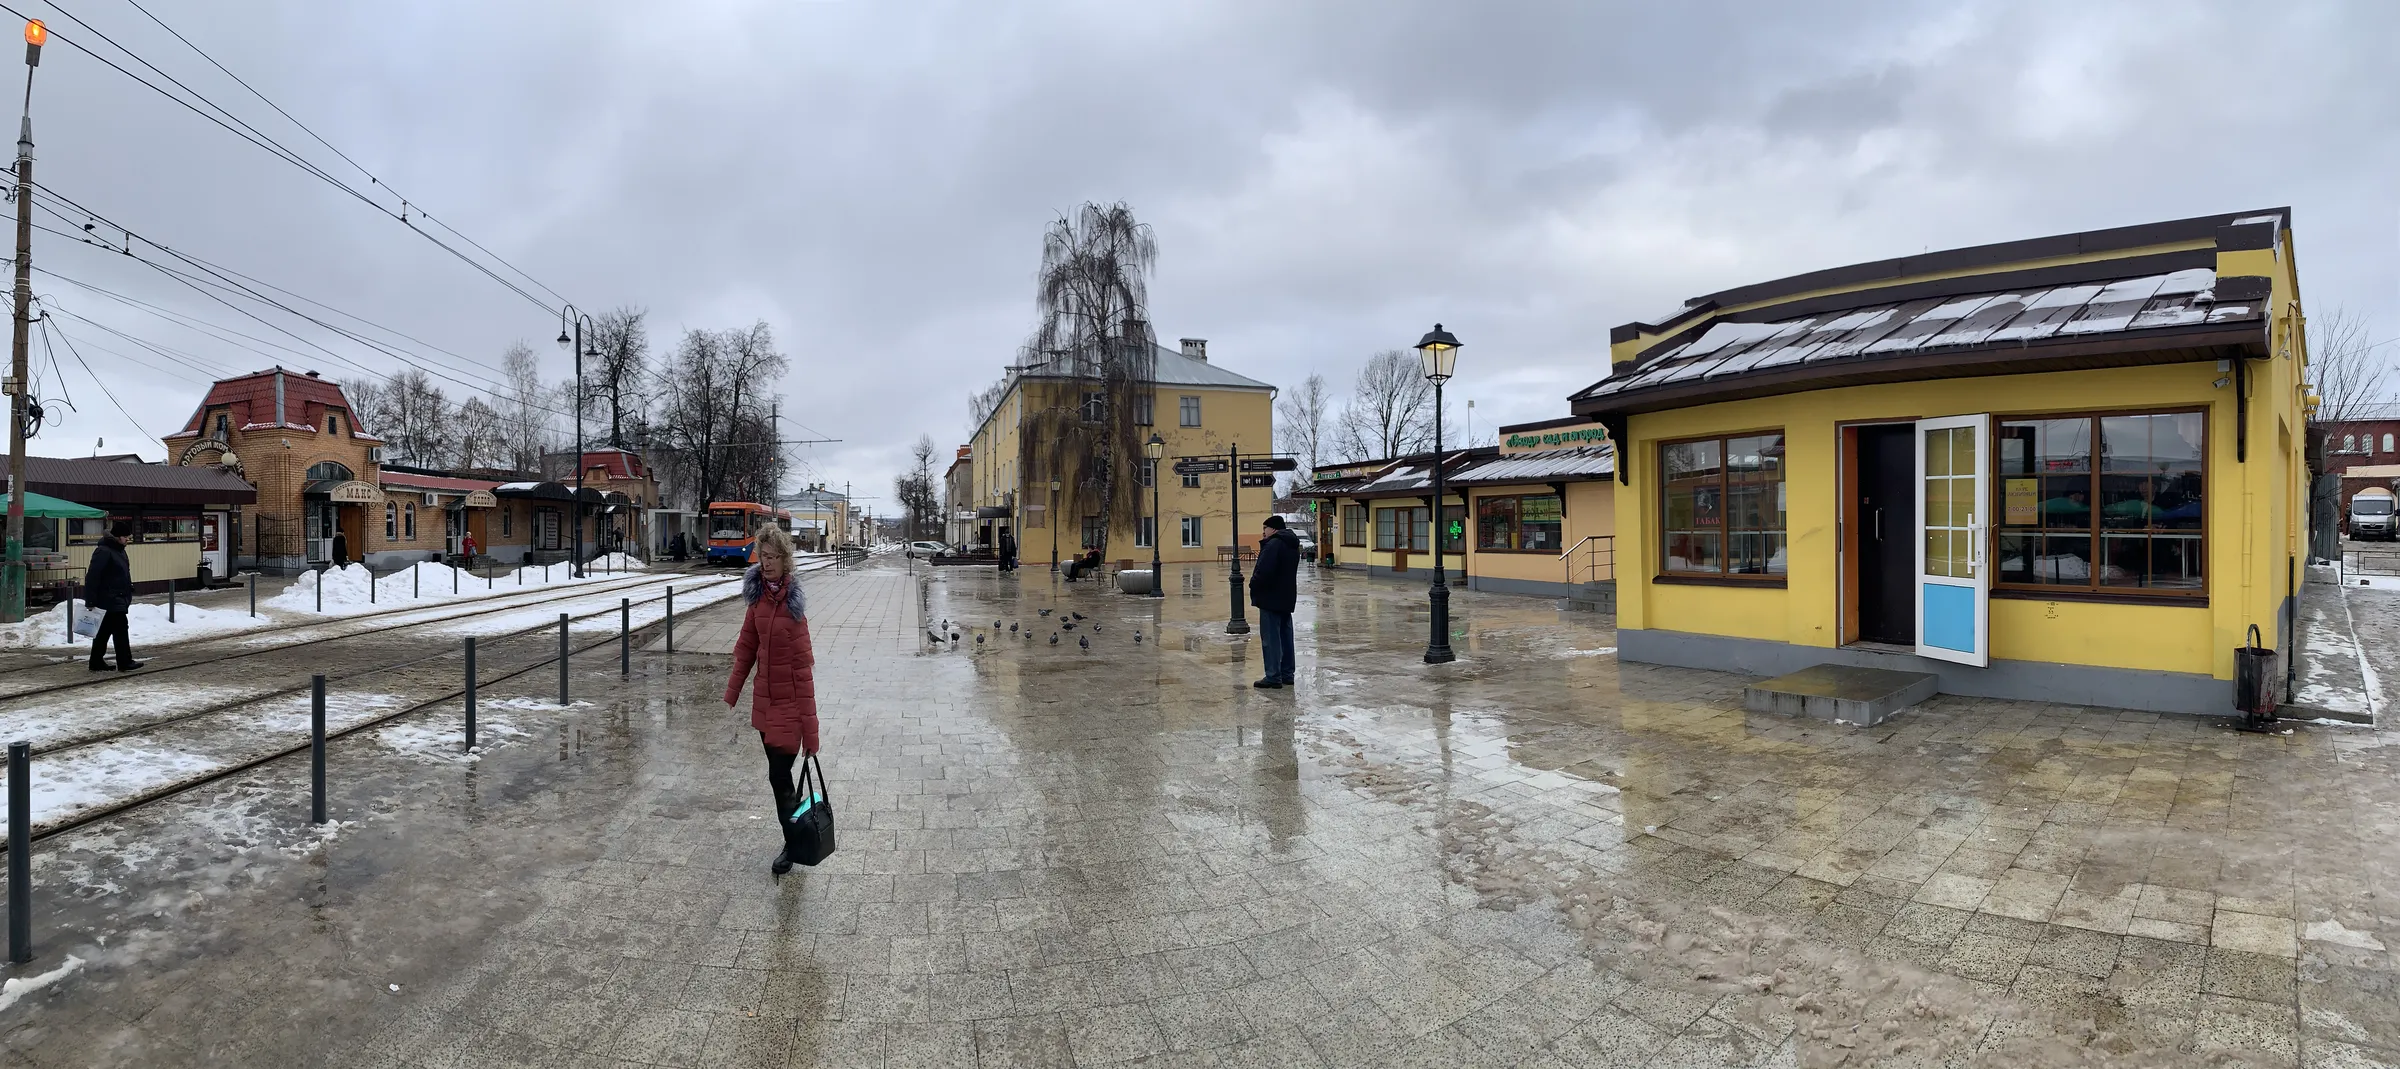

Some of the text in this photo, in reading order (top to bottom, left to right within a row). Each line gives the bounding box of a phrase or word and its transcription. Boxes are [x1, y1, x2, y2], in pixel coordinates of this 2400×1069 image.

[1543, 433, 1561, 446] сад
[1561, 432, 1570, 442] и
[1570, 427, 1606, 443] огород
[182, 440, 212, 467] ОРГОВЫЙ
[346, 488, 372, 499] МАКС
[1695, 516, 1721, 525] ТАБАК
